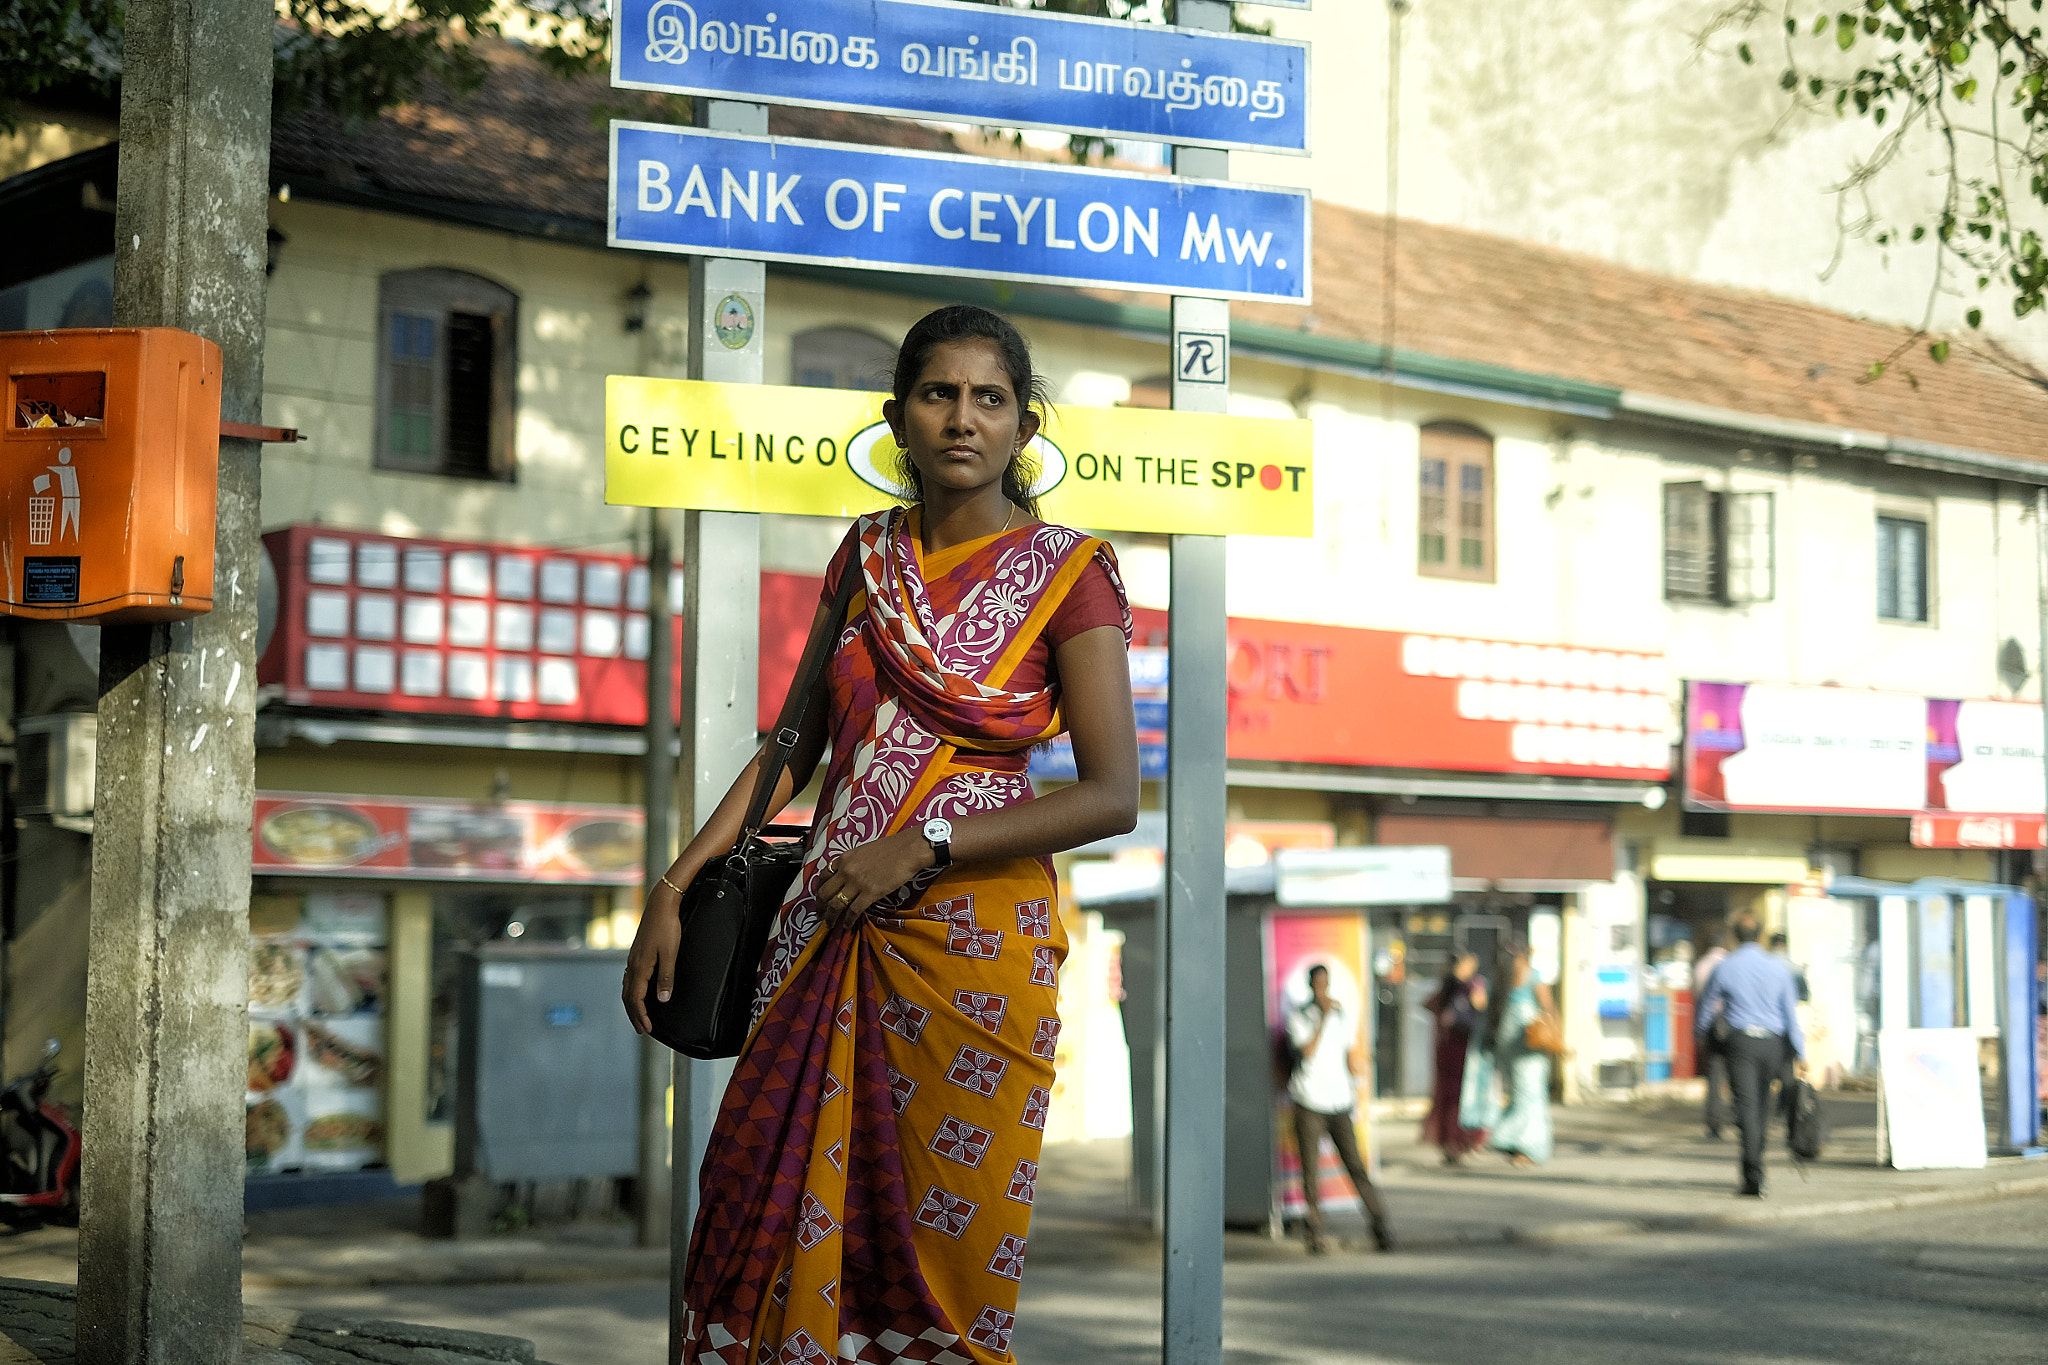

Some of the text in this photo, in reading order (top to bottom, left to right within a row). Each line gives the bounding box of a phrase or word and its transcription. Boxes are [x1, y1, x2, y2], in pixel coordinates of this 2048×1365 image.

[645, 0, 1286, 122] இலங்கை வங்கி மாவத்தை
[637, 159, 1288, 270] BANK OF CEYLON Mw.
[619, 424, 1307, 493] CEYLINCO ON THE SPOT
[1227, 637, 1332, 704] ORT
